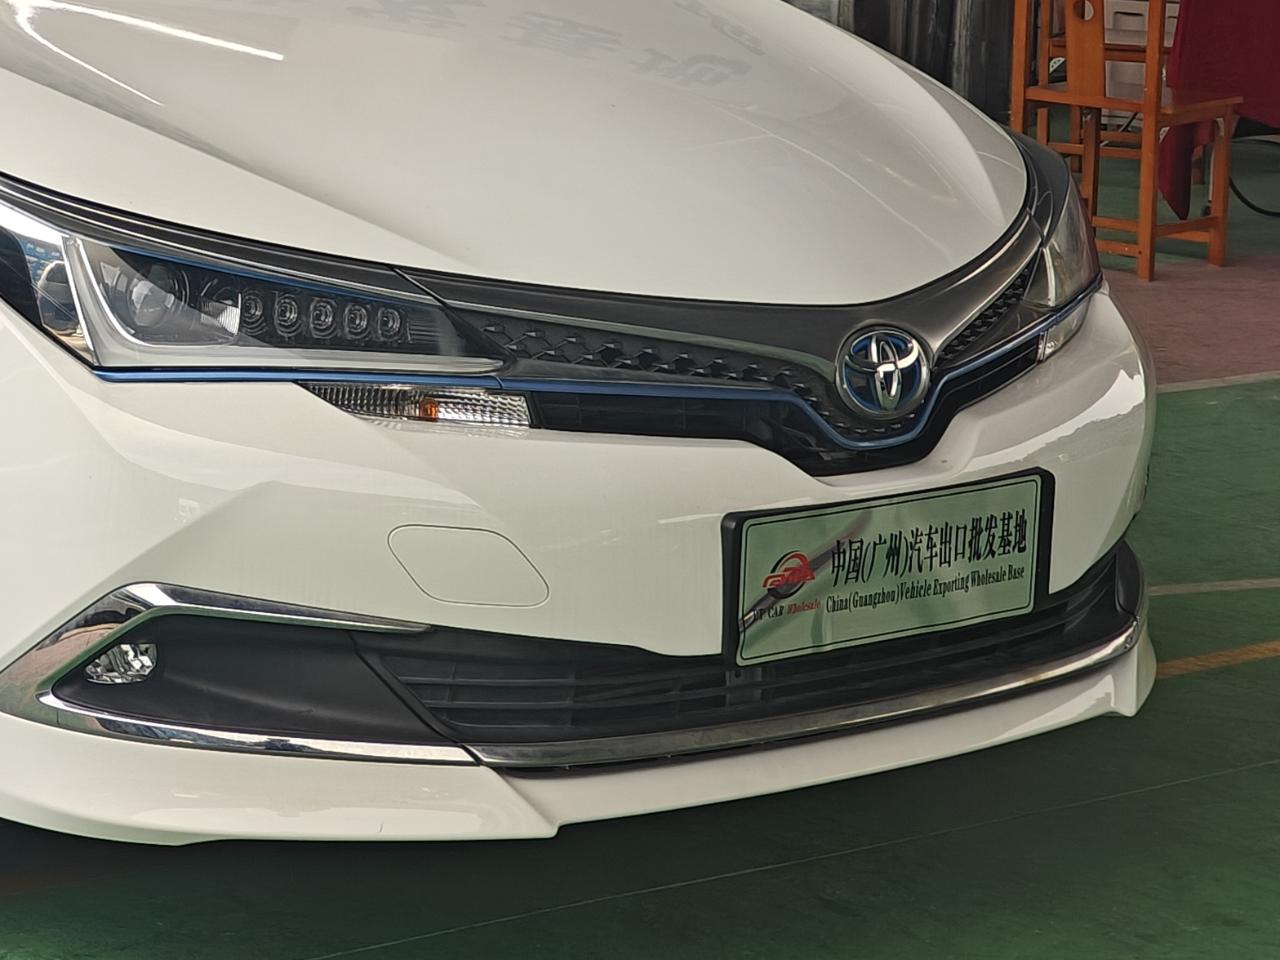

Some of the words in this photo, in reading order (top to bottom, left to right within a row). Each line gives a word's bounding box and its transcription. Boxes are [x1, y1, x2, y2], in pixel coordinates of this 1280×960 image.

[830, 508, 1028, 587] 中国(广州)汽车出口批发基地
[933, 573, 970, 597] Exporting
[970, 569, 1007, 587] Wholesale
[1007, 565, 1025, 580] Base
